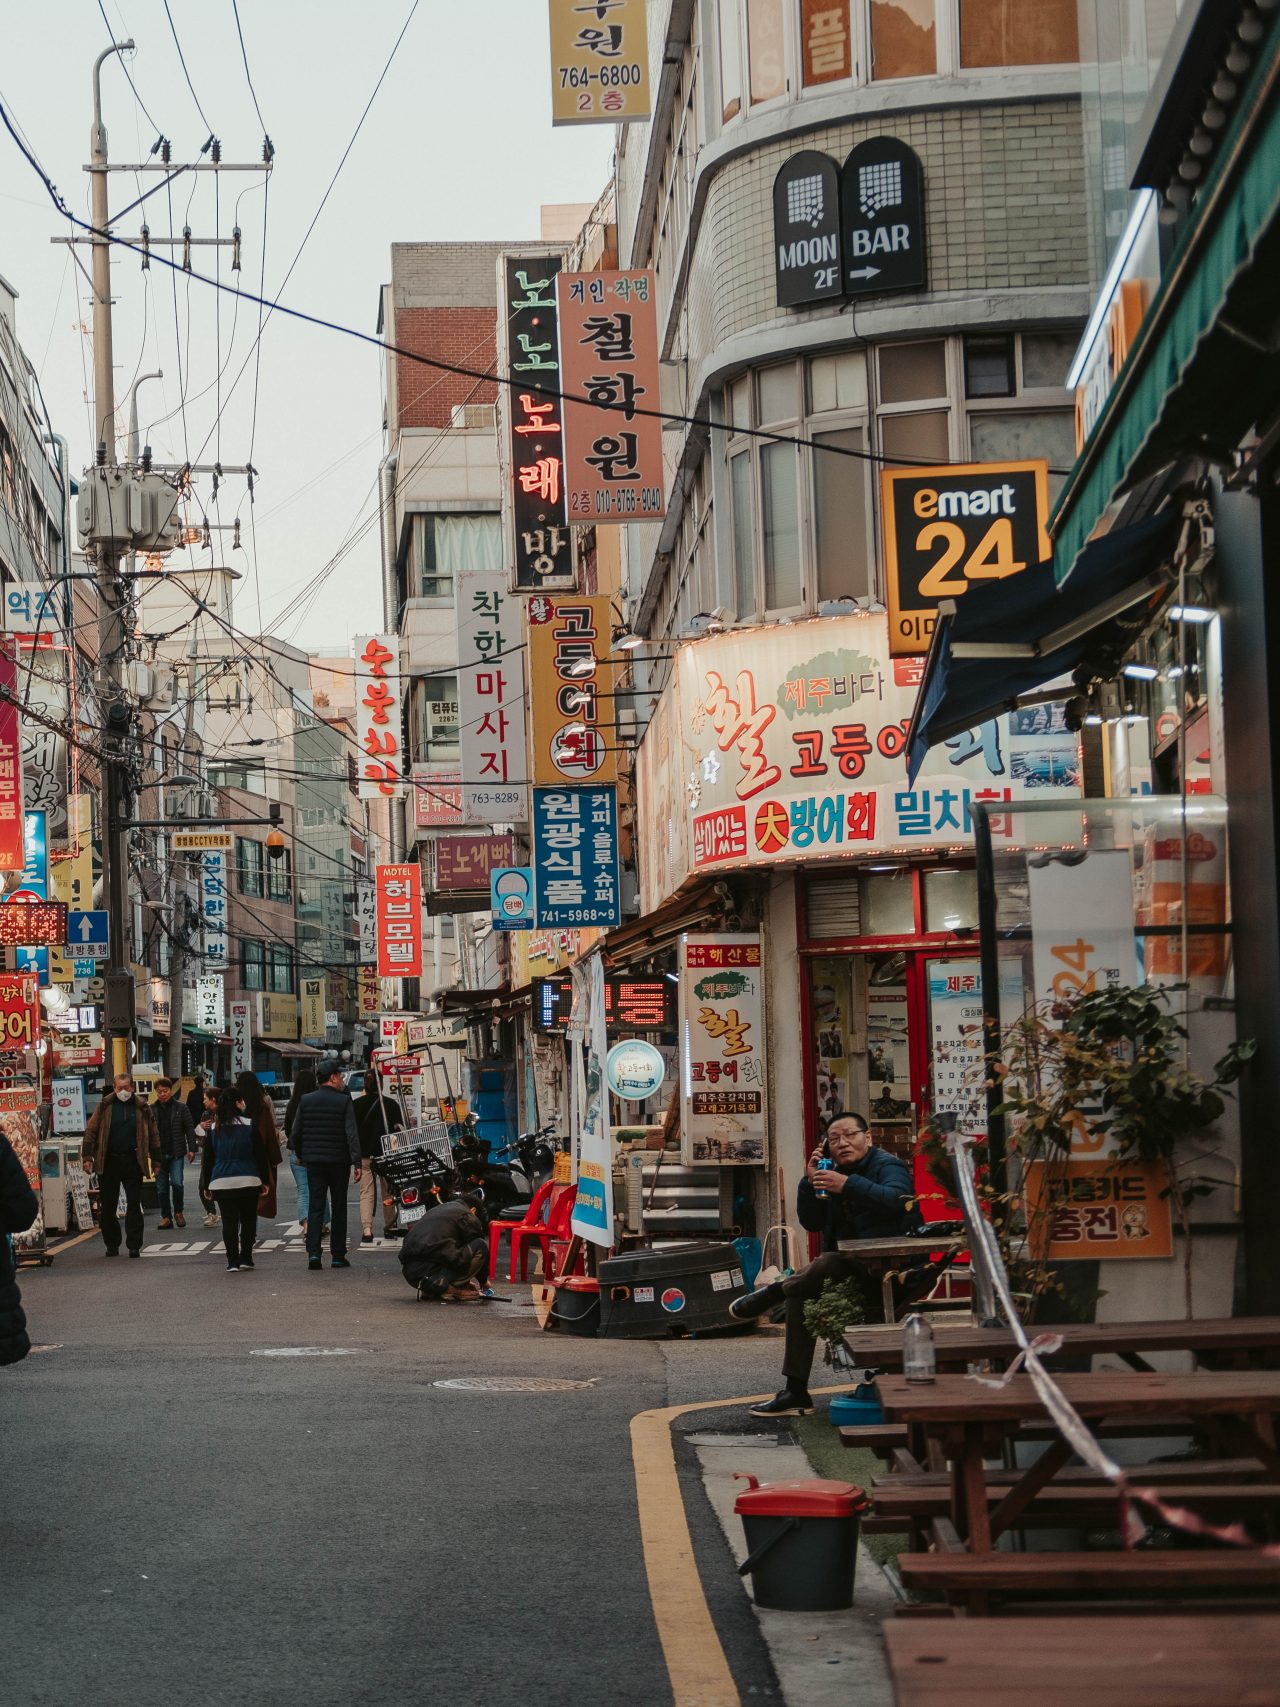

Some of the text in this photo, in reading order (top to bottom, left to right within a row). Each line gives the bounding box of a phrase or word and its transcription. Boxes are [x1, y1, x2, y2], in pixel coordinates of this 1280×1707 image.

[560, 64, 640, 88] 764-6800
[779, 224, 910, 270] MOON BAR
[815, 267, 839, 289] 2F
[580, 313, 645, 482] 철학원
[572, 488, 661, 513] 2층 010-8766-9040
[914, 483, 1017, 518] emart
[915, 518, 1027, 597] 24
[7, 590, 57, 622] 억조
[553, 605, 599, 723] 고등어
[784, 671, 886, 710] 제주바다
[361, 639, 396, 795] 숯불치킨
[704, 669, 782, 800] 활
[790, 723, 913, 779] 고등어
[472, 793, 519, 803] 763-8289
[540, 794, 586, 905] 원광식품
[693, 811, 747, 862] 살아있는
[0, 853, 14, 865] 2F
[383, 867, 412, 877] MOTEL
[384, 879, 414, 963] 허브모텔
[505, 900, 522, 910] 담배
[541, 908, 615, 923] 741-5968~9
[65, 943, 107, 955] 일방통행
[687, 947, 760, 964] 제주 해산물
[702, 982, 756, 998] 제주바다
[203, 992, 217, 1025] 양꼬치
[63, 1034, 91, 1048] 억조
[697, 1006, 753, 1057] 활
[691, 1060, 738, 1083] 고등어
[698, 1092, 757, 1102] 제주은갈치회
[698, 1103, 757, 1114] 고래고기육회
[1050, 1206, 1119, 1242] 충전
